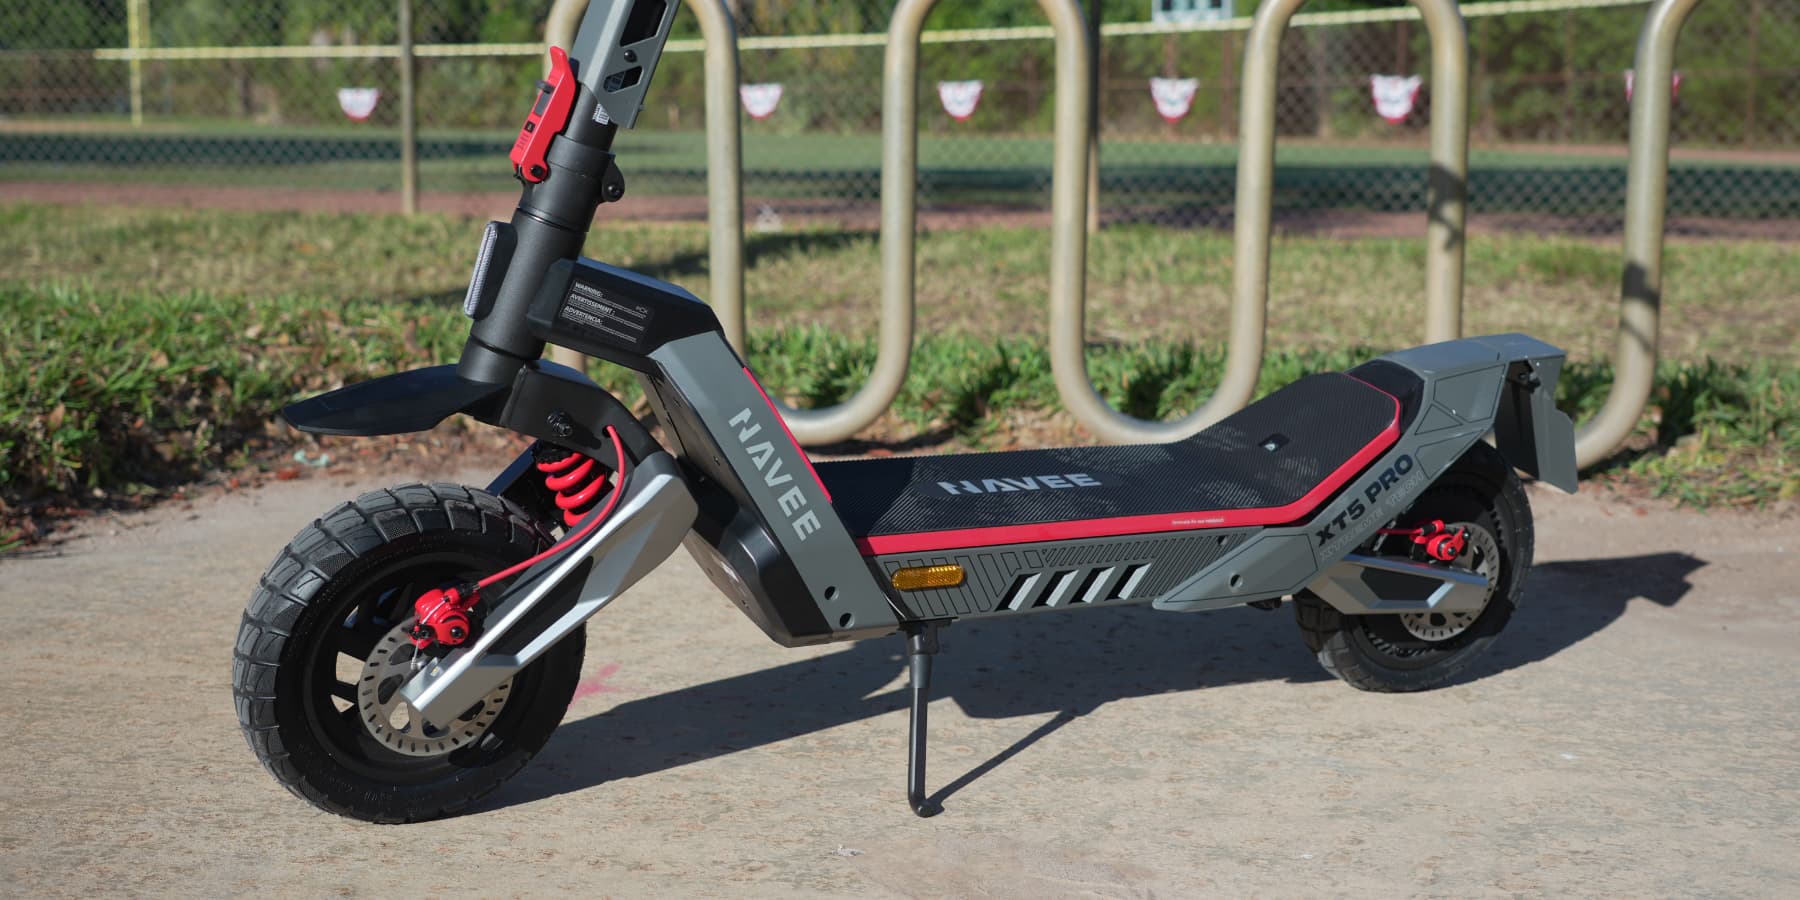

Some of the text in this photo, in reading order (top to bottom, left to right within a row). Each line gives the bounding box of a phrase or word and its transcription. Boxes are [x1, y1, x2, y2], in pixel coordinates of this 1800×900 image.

[728, 407, 822, 542] NAVEE
[937, 473, 1103, 495] NAVEE
[1315, 498, 1366, 548] XT5
[1364, 454, 1414, 504] PRO
